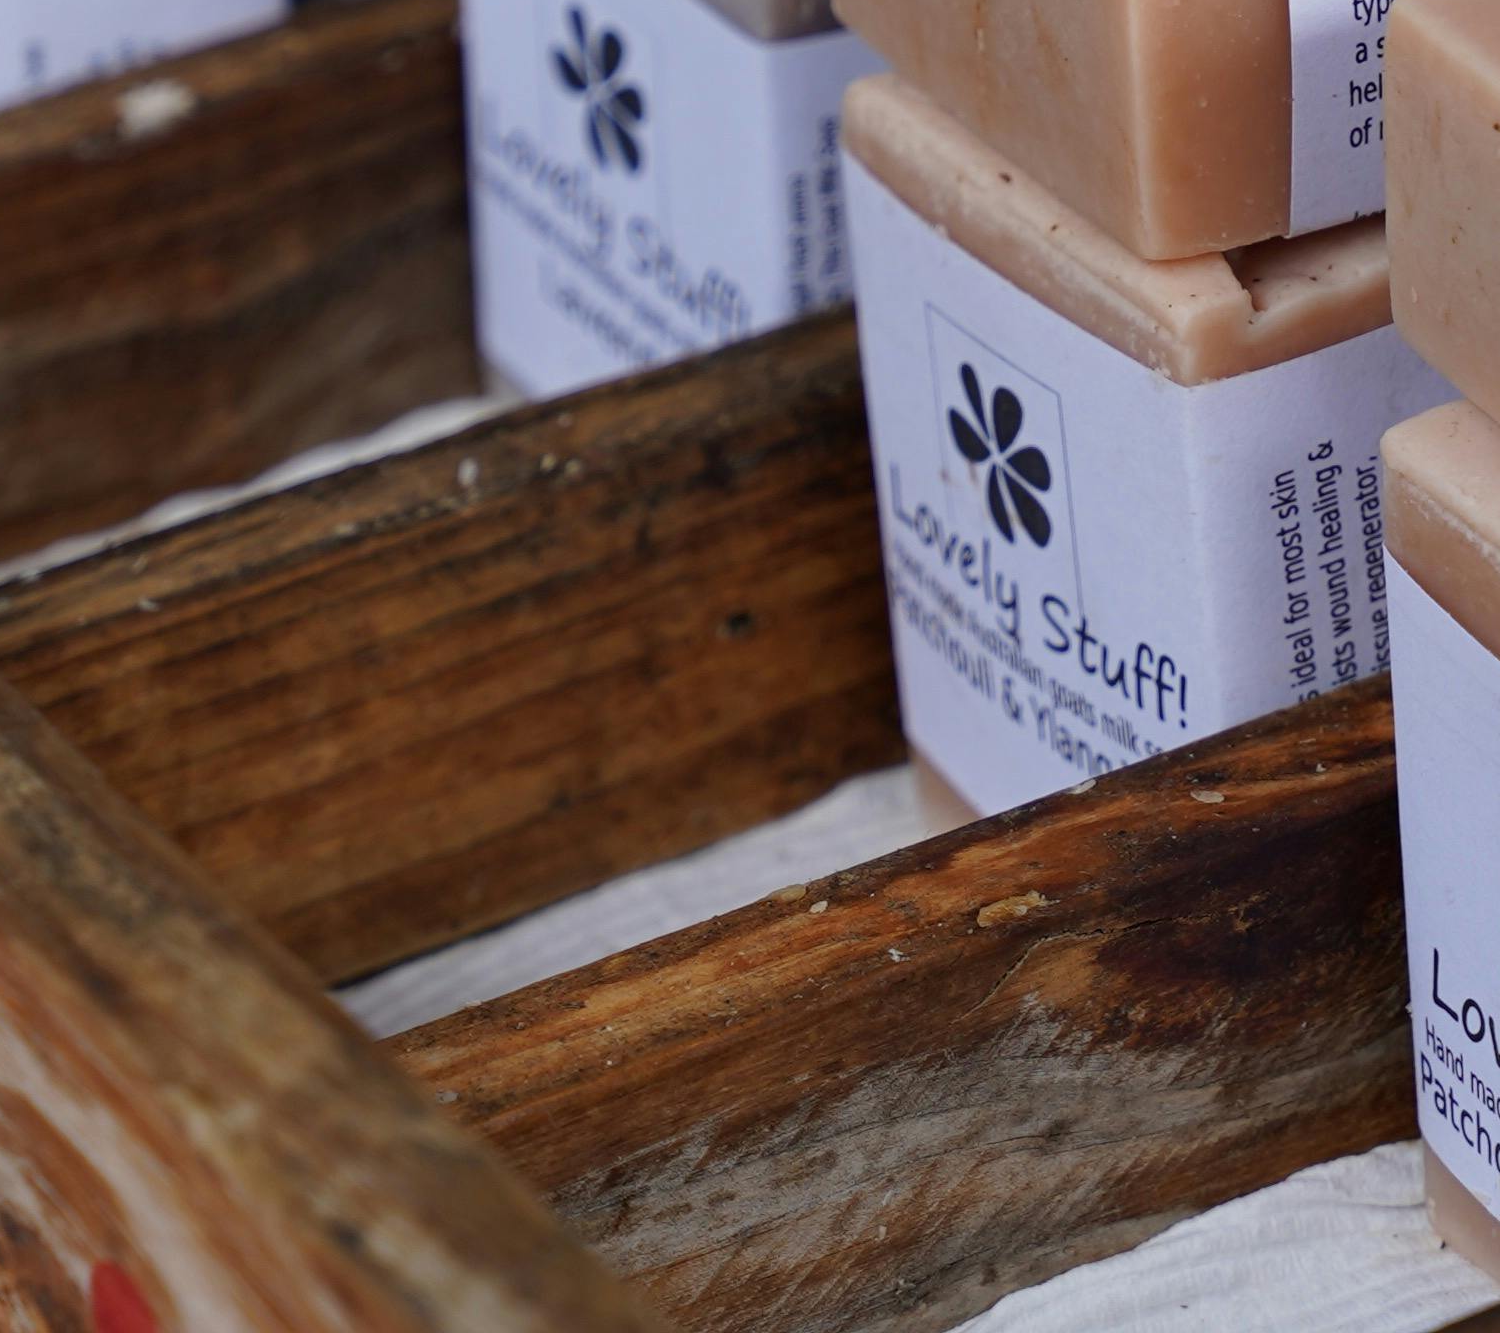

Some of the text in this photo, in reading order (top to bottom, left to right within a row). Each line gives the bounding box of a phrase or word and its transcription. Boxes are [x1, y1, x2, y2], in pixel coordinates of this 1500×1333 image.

[1354, 40, 1369, 65] a
[1348, 72, 1383, 107] hel
[1349, 116, 1373, 149] of
[1269, 468, 1300, 521] skin
[1276, 521, 1305, 584] most
[1308, 439, 1358, 686] ists wound healing &
[889, 460, 1188, 729] Lovely Stuff!
[1284, 591, 1310, 626] for
[1285, 628, 1318, 689] ideal
[1001, 675, 1023, 725] &
[1099, 712, 1140, 755] milk
[1425, 1017, 1465, 1083] Hand
